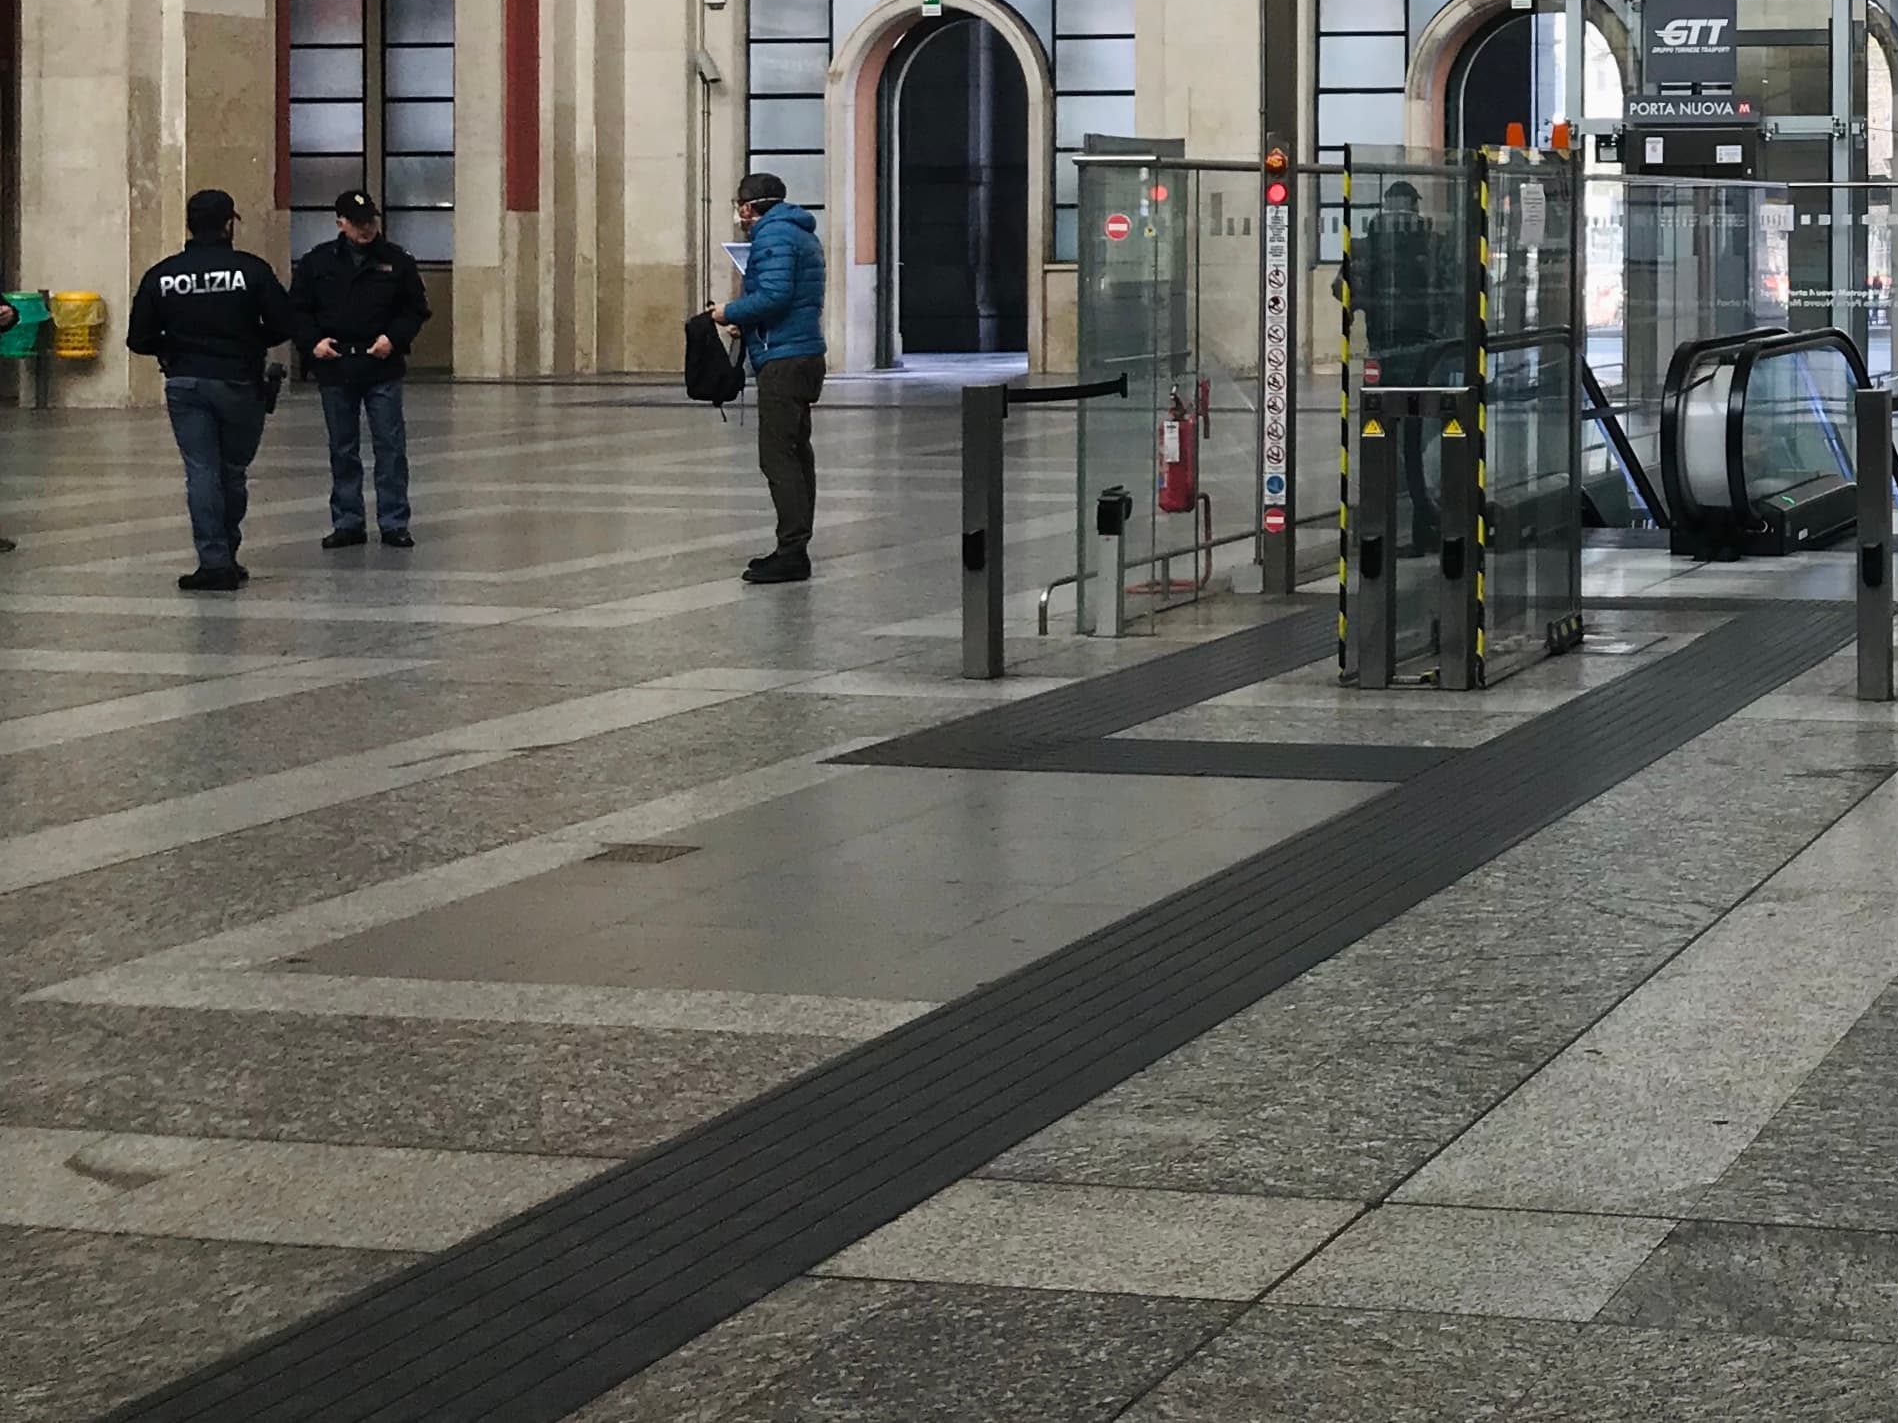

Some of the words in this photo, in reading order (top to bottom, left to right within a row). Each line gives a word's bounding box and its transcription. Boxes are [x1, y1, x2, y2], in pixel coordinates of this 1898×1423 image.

[1654, 18, 1729, 46] GTT
[1629, 102, 1676, 115] PORTA
[1679, 101, 1735, 115] NUOVA
[1738, 102, 1751, 114] M
[160, 270, 247, 297] POLIZIA
